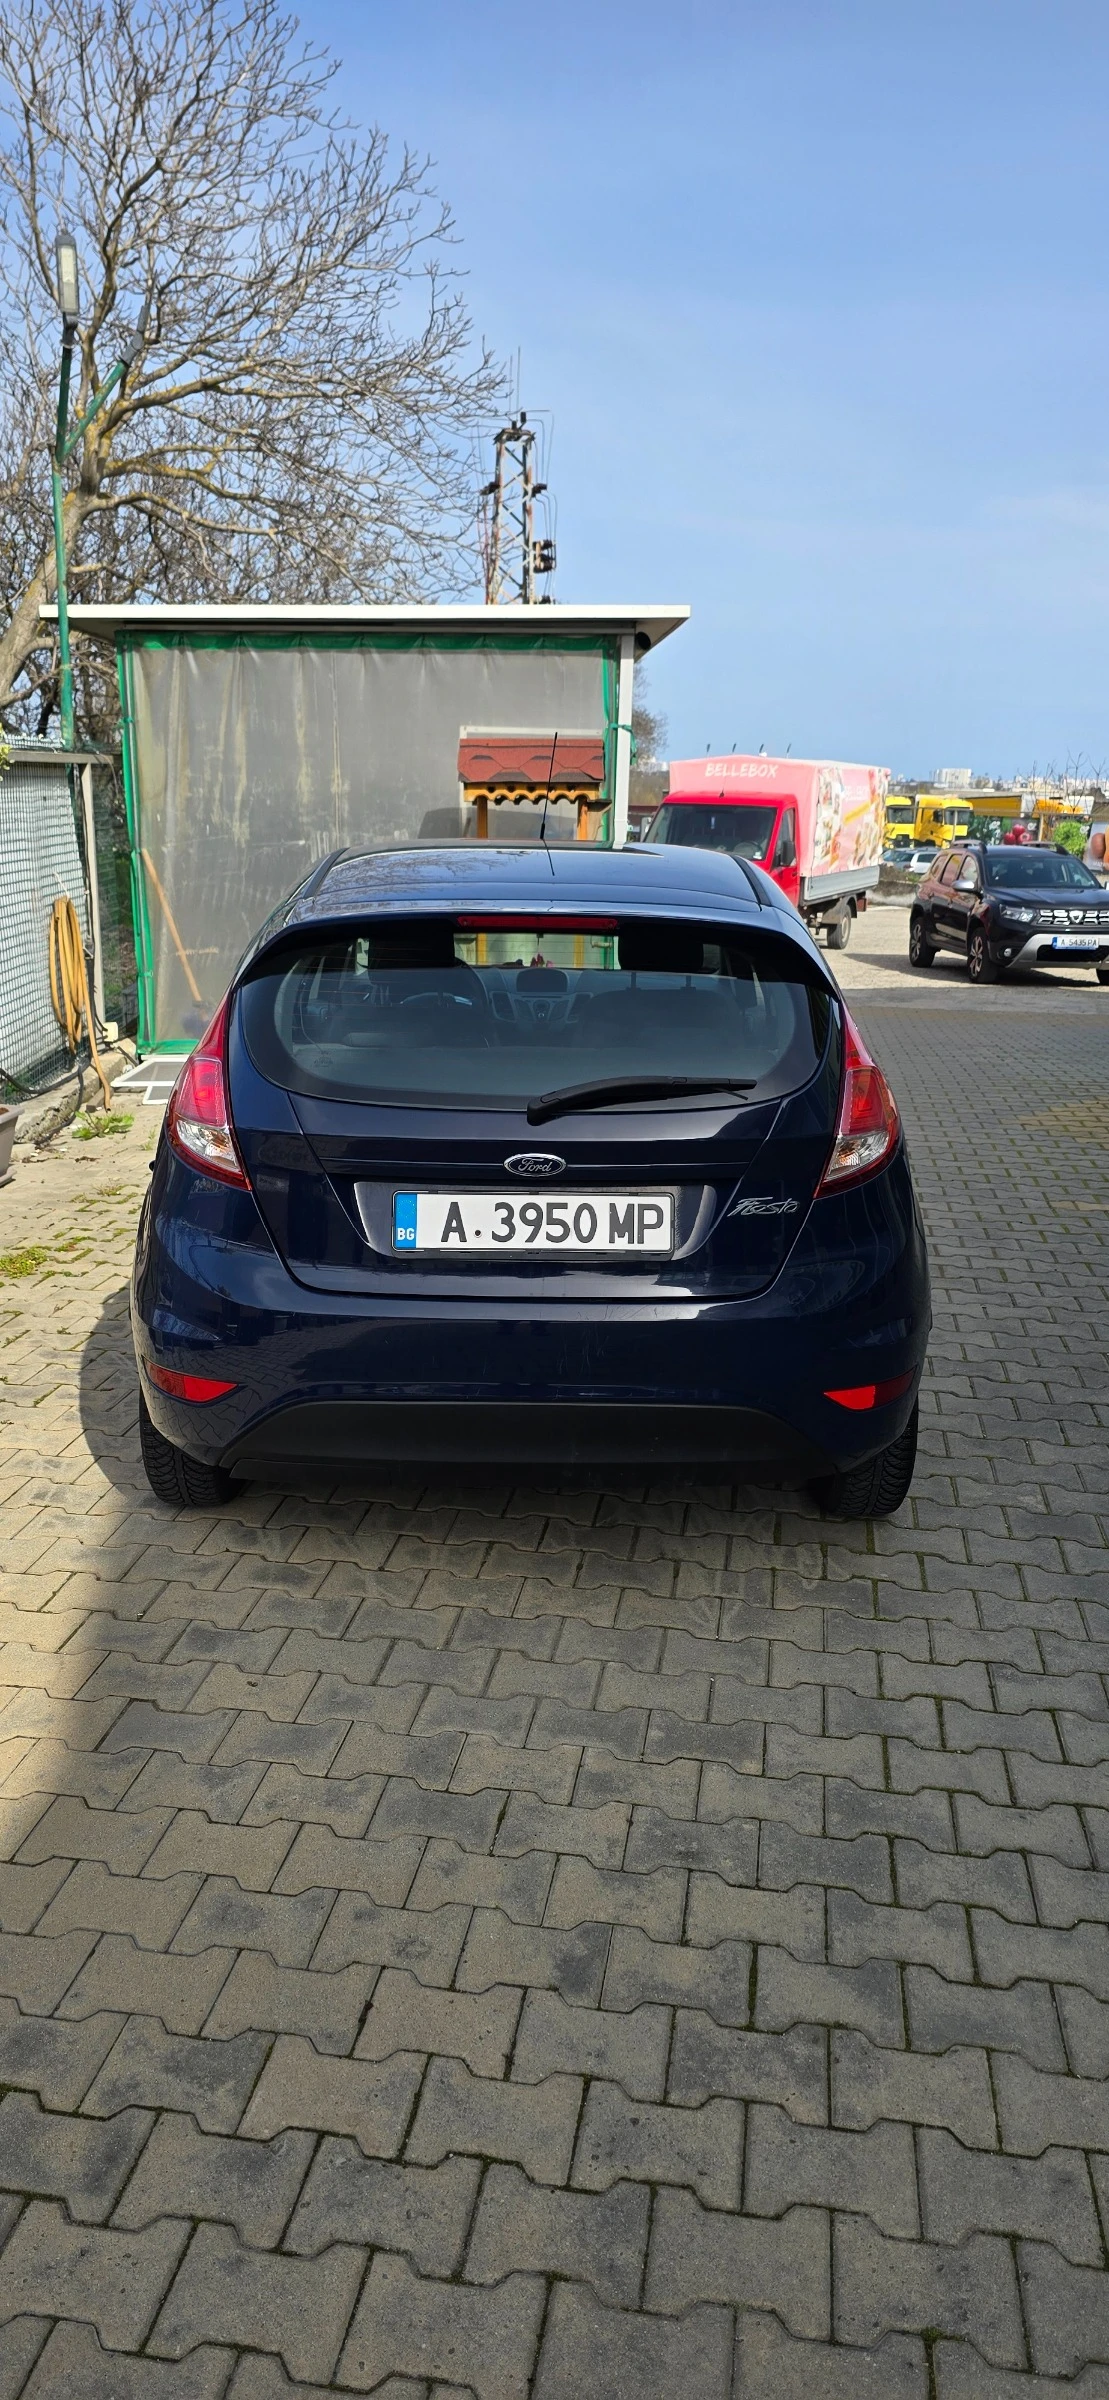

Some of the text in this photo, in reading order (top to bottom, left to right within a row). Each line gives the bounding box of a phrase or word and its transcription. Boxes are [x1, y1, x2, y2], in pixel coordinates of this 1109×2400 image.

[705, 763, 778, 778] BELLEBOX
[518, 1157, 553, 1171] Ford
[727, 1196, 799, 1217] Fiesta
[491, 1201, 598, 1244] 3950
[608, 1202, 664, 1244] MP
[397, 1227, 415, 1241] BG
